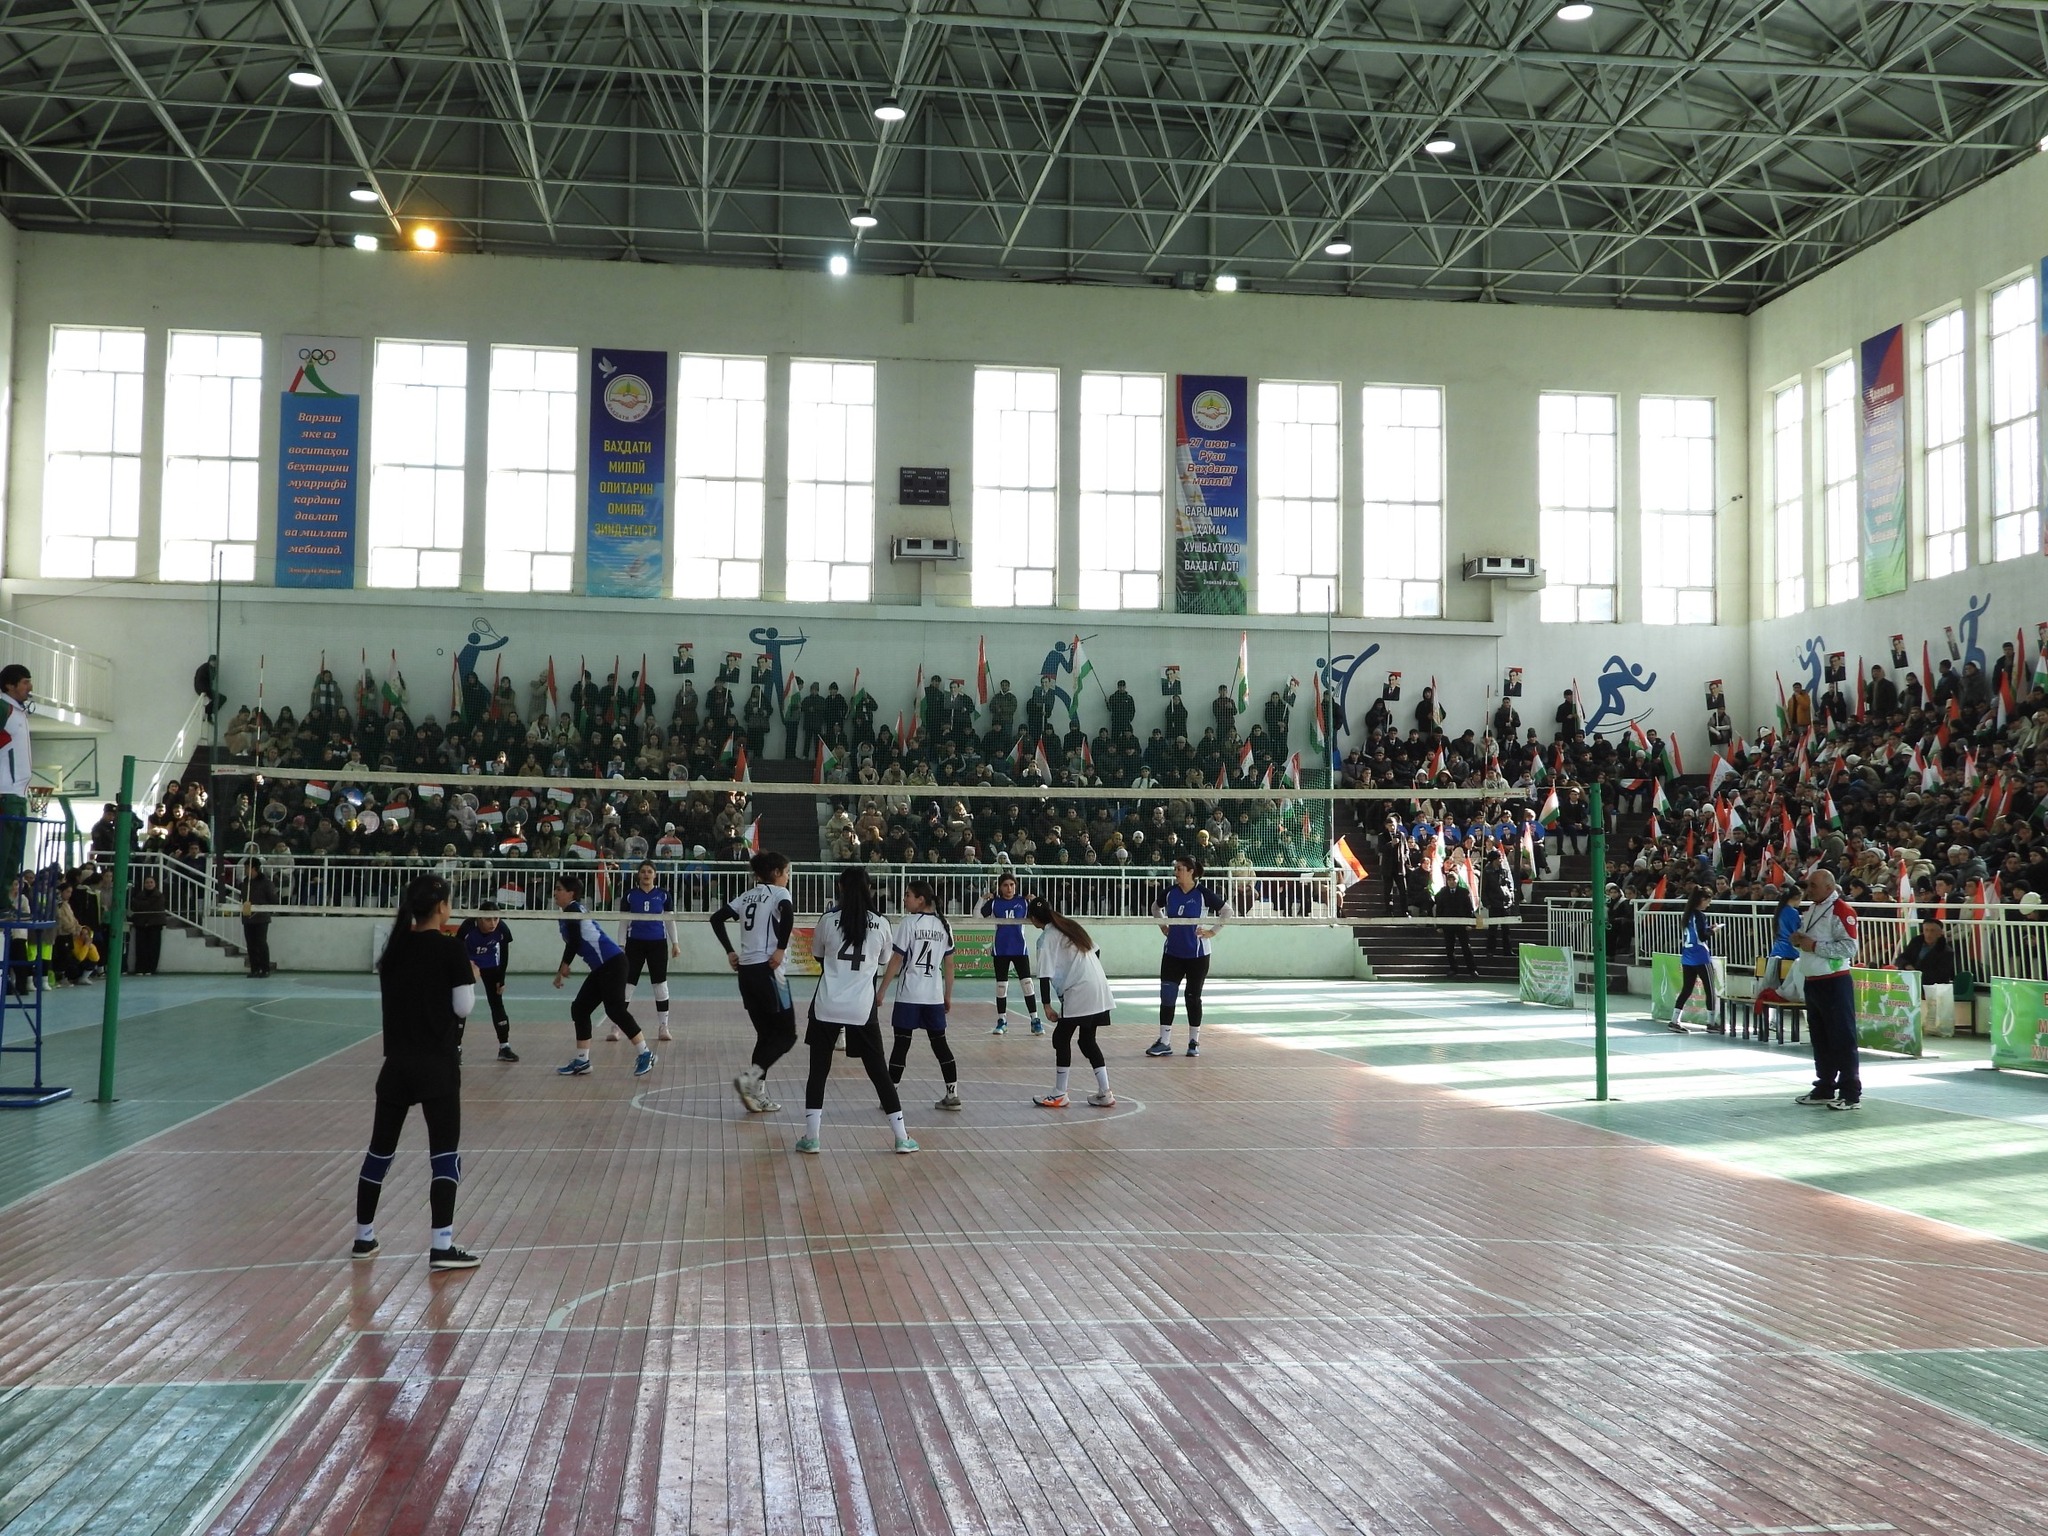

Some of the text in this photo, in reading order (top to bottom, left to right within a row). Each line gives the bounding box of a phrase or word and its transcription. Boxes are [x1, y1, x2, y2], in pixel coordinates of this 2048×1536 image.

[298, 412, 342, 424] Варзиш
[301, 431, 337, 439] яке аз
[1190, 437, 1204, 448] 27
[599, 481, 654, 495] ОЛИТАРИН
[293, 495, 341, 506] кардани
[607, 502, 645, 516] ОМИЛИ
[1185, 506, 1239, 518] САРЧАШМАИ
[294, 511, 339, 521] давлат
[284, 529, 348, 538] ва миллат
[1220, 561, 1239, 572] АСТ!
[744, 903, 757, 931] 9
[837, 940, 866, 971] 4
[914, 940, 935, 978] 4
